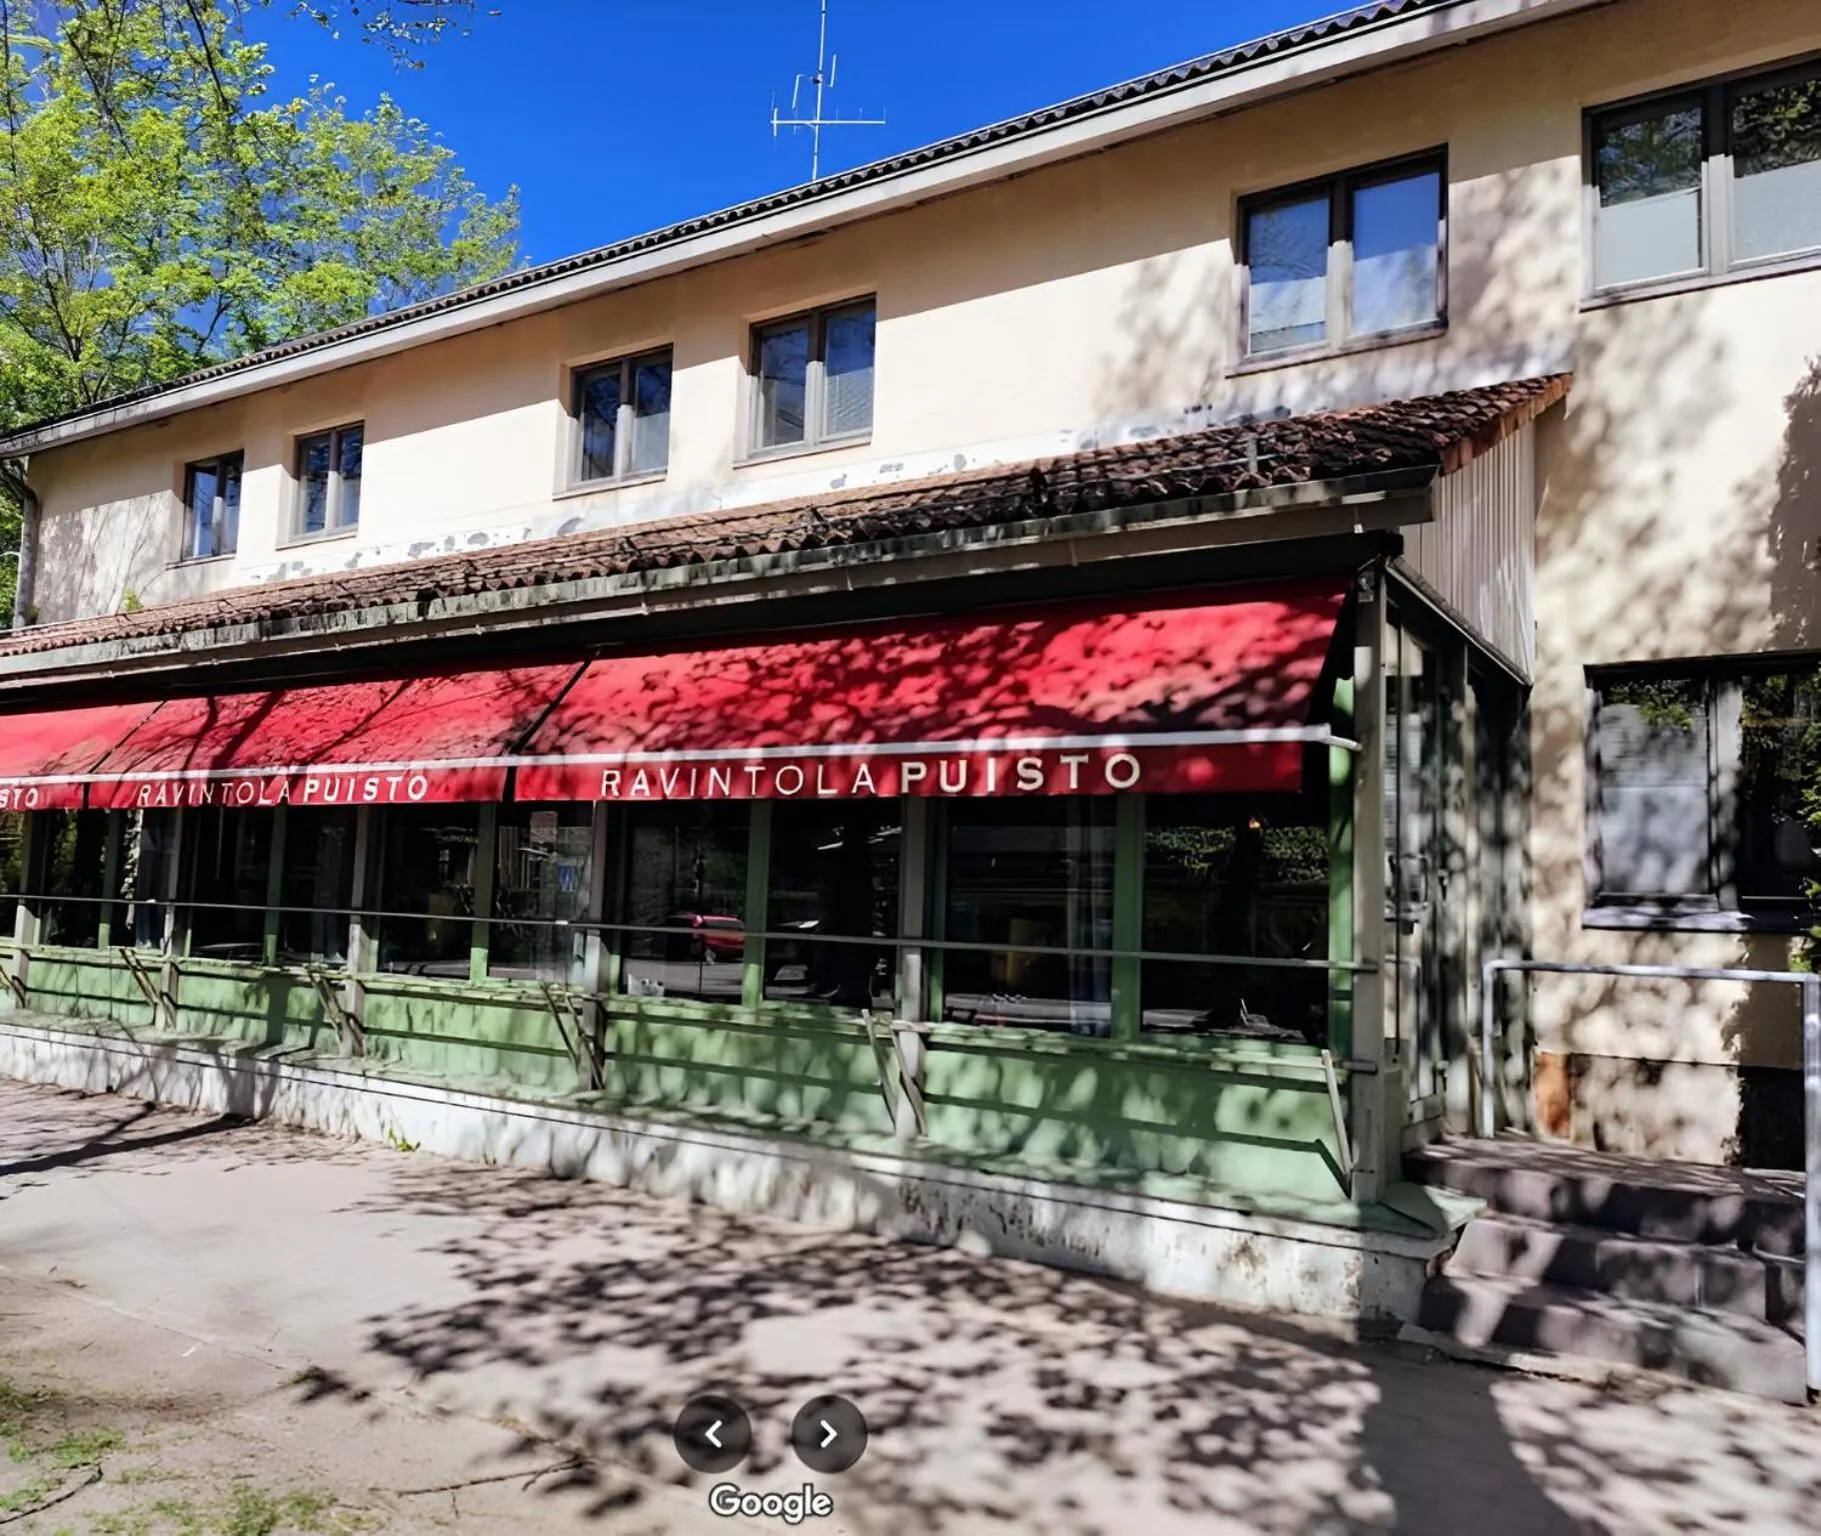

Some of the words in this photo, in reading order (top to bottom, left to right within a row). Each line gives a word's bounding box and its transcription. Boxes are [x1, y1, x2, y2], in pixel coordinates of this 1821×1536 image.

[137, 779, 290, 807] RAVINTOLA
[302, 774, 428, 803] PUISTO
[601, 762, 877, 797] RAVINTOLA
[901, 753, 1141, 794] PUISTO
